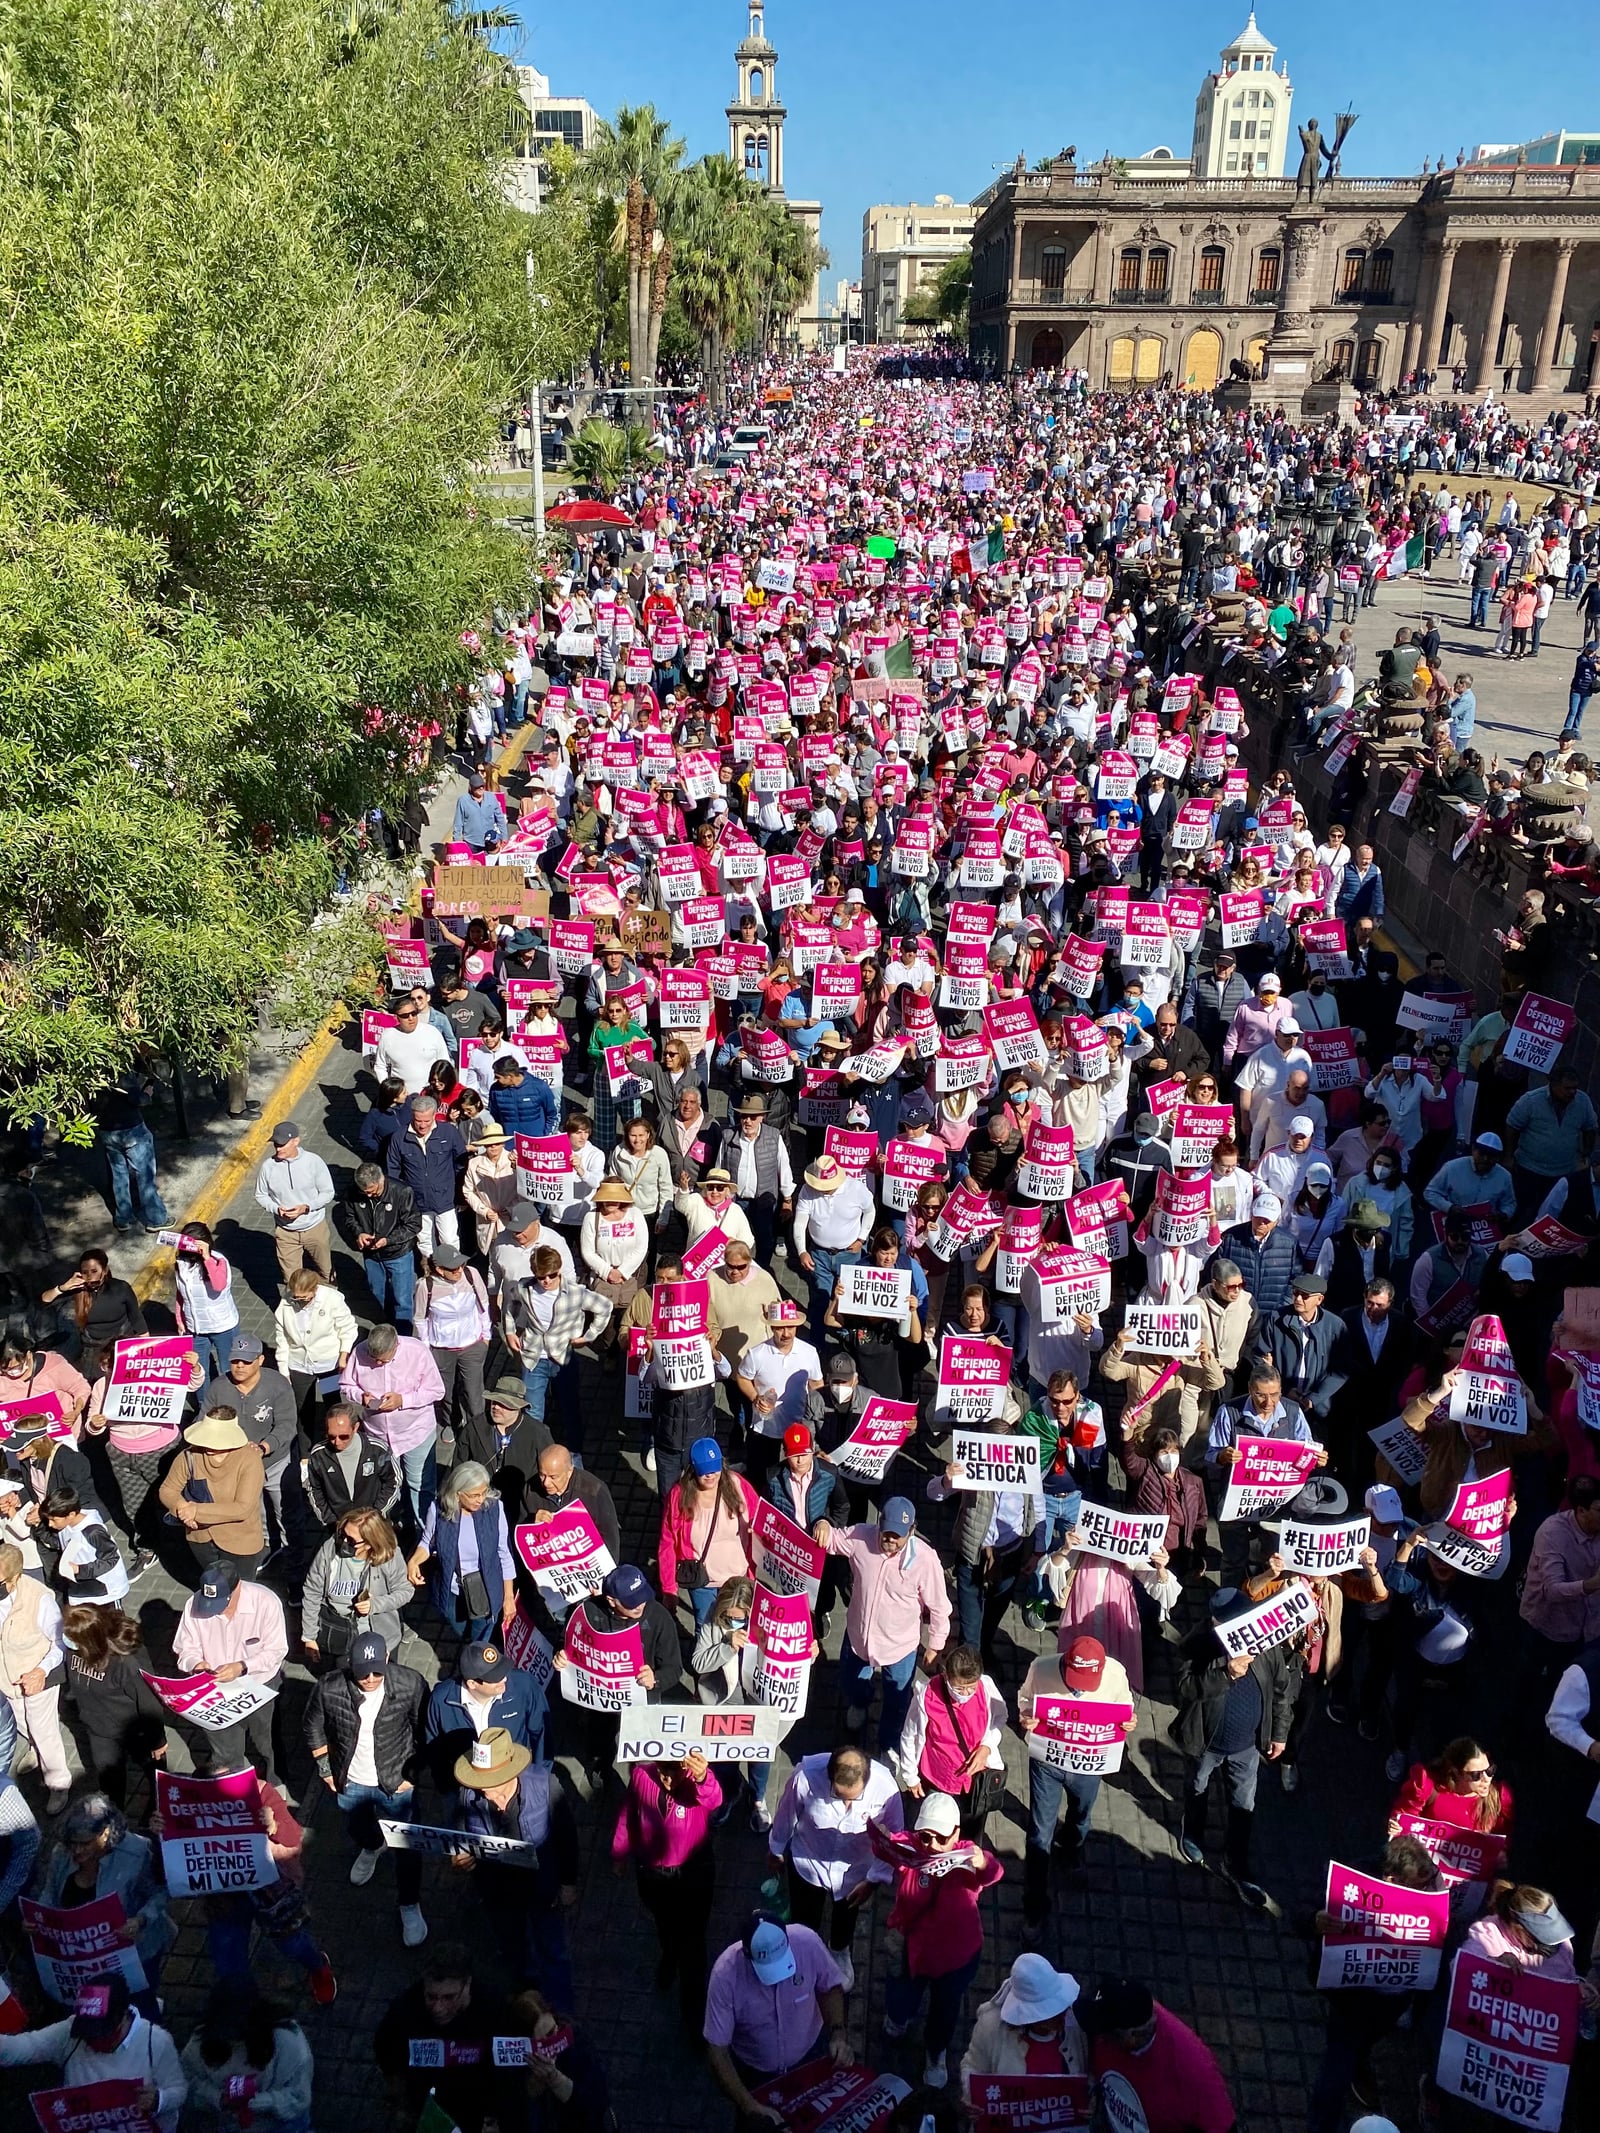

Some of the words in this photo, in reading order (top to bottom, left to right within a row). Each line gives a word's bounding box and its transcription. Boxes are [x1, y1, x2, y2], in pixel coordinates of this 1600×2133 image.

[906, 839, 928, 847] INE
[968, 841, 997, 849] DEFIENDO
[974, 848, 997, 856] INE
[908, 865, 923, 873] VOZ
[978, 873, 994, 881] VOZ
[436, 902, 461, 913] POR
[461, 901, 480, 912] ESO
[1141, 924, 1166, 934] INE
[1131, 945, 1162, 953] DEFIENDE
[1141, 938, 1162, 946] INE
[1130, 954, 1141, 963] MI
[1144, 954, 1162, 964] VOZ
[667, 981, 702, 992] DEFIENDO
[676, 991, 702, 999] INE
[1005, 1020, 1035, 1032] INE
[1533, 1020, 1564, 1036] INE
[1529, 1035, 1554, 1050] INE
[1319, 1049, 1349, 1060] INE
[1527, 1052, 1547, 1067] VOZ
[1326, 1062, 1352, 1071] INE
[522, 1150, 565, 1160] DEFIENDO
[533, 1159, 568, 1169] INE
[524, 1171, 534, 1181] EL
[536, 1174, 564, 1184] INE
[525, 1180, 564, 1191] DEFIENDE
[526, 1189, 538, 1200] MI
[541, 1190, 564, 1201] VOZ
[854, 1269, 864, 1280] EL
[867, 1270, 900, 1282] INE
[853, 1281, 899, 1294] DEFIENDE
[853, 1292, 869, 1306] MI
[872, 1294, 898, 1308] VOZ
[668, 1319, 700, 1332] INE
[1128, 1314, 1199, 1331] #ELINENO
[671, 1340, 703, 1354] INE
[1136, 1331, 1189, 1348] SETOCA
[126, 1357, 183, 1370] DEFIENDO
[950, 1358, 1001, 1370] DEFIENDO
[139, 1367, 183, 1379] INE
[681, 1368, 706, 1381] VOZ
[962, 1369, 1001, 1380] INE
[123, 1385, 133, 1395] EL
[137, 1385, 173, 1396] INE
[951, 1387, 961, 1397] EL
[963, 1386, 995, 1397] INE
[1485, 1376, 1517, 1393] INE
[121, 1394, 173, 1406] DEFIENDE
[949, 1397, 993, 1408] DEFIENDE
[1468, 1389, 1518, 1408] DEFIENDE
[118, 1406, 136, 1418] MI
[140, 1407, 170, 1419] VOZ
[947, 1408, 962, 1419] MI
[966, 1407, 992, 1419] VOZ
[1466, 1403, 1482, 1418] MI
[1488, 1407, 1519, 1426] VOZ
[956, 1441, 1038, 1466] #ELINENO
[1247, 1445, 1275, 1459] #YO
[965, 1461, 1027, 1485] SETOCA
[1258, 1471, 1301, 1483] INE
[1241, 1488, 1253, 1497] EL
[1255, 1488, 1293, 1497] INE
[1081, 1508, 1165, 1540] #ELINENO
[524, 1528, 551, 1546] #YO
[529, 1525, 587, 1557] DEFIENDO
[762, 1522, 814, 1563] DEFIENDO
[1087, 1532, 1150, 1557] SETOCA
[1283, 1525, 1367, 1552] #ELINENO
[550, 1535, 595, 1562] INE
[1291, 1543, 1355, 1569] SETOCA
[773, 1543, 814, 1573] INE
[1437, 1539, 1457, 1558] MI
[1460, 1552, 1499, 1576] VOZ
[548, 1568, 561, 1579] EL
[560, 1556, 600, 1574] INE
[560, 1583, 580, 1600] MI
[759, 1597, 786, 1622] #YO
[757, 1619, 808, 1639] DEFIENDO
[1227, 1592, 1310, 1652] #ELINENO
[571, 1634, 631, 1662] DEFIENDO
[766, 1637, 808, 1656] INE
[585, 1652, 635, 1674] INE
[765, 1663, 803, 1680] INE
[576, 1668, 587, 1681] EL
[590, 1676, 632, 1691] INE
[751, 1667, 801, 1695] DEFIENDE
[577, 1679, 632, 1701] DEFIENDE
[577, 1690, 596, 1705] MI
[214, 1712, 232, 1727] MI
[232, 1692, 263, 1714] VOZ
[769, 1696, 798, 1714] VOZ
[1047, 1706, 1081, 1721] #YO
[701, 1713, 756, 1737] INE
[1064, 1730, 1116, 1743] INE
[622, 1741, 664, 1759] NO
[670, 1741, 704, 1758] Se
[710, 1741, 770, 1759] Toca
[1046, 1747, 1107, 1763] DEFIENDE
[1047, 1740, 1060, 1749] EL
[1065, 1745, 1109, 1756] INE
[1045, 1754, 1065, 1767] MI
[1071, 1760, 1106, 1772] VOZ
[169, 1800, 248, 1817] DEFIENDO
[195, 1812, 255, 1830] INE
[184, 1842, 201, 1858] EL
[203, 1839, 253, 1855] INE
[446, 1841, 500, 1860] INE
[186, 1855, 255, 1872] DEFIENDE
[188, 1873, 213, 1892] MI
[217, 1870, 259, 1888] VOZ
[1343, 1882, 1385, 1911] #YO
[1340, 1904, 1431, 1929] DEFIENDO
[1363, 1925, 1431, 1942] INE
[60, 1936, 117, 1956] INE
[1344, 1950, 1361, 1962] EL
[1366, 1948, 1422, 1961] INE
[1343, 1962, 1420, 1975] DEFIENDE
[1340, 1974, 1367, 1986] MI
[1373, 1975, 1418, 1987] VOZ
[1468, 1992, 1560, 2033] DEFIENDO
[1490, 2020, 1561, 2054] INE
[1465, 2043, 1484, 2061] EL
[1488, 2051, 1550, 2082] INE
[1462, 2061, 1546, 2100] DEFIENDE
[986, 2095, 1073, 2117] DEFIENDO
[1459, 2079, 1487, 2101] MI
[1495, 2092, 1541, 2122] VOZ
[1011, 2111, 1077, 2128] INE
